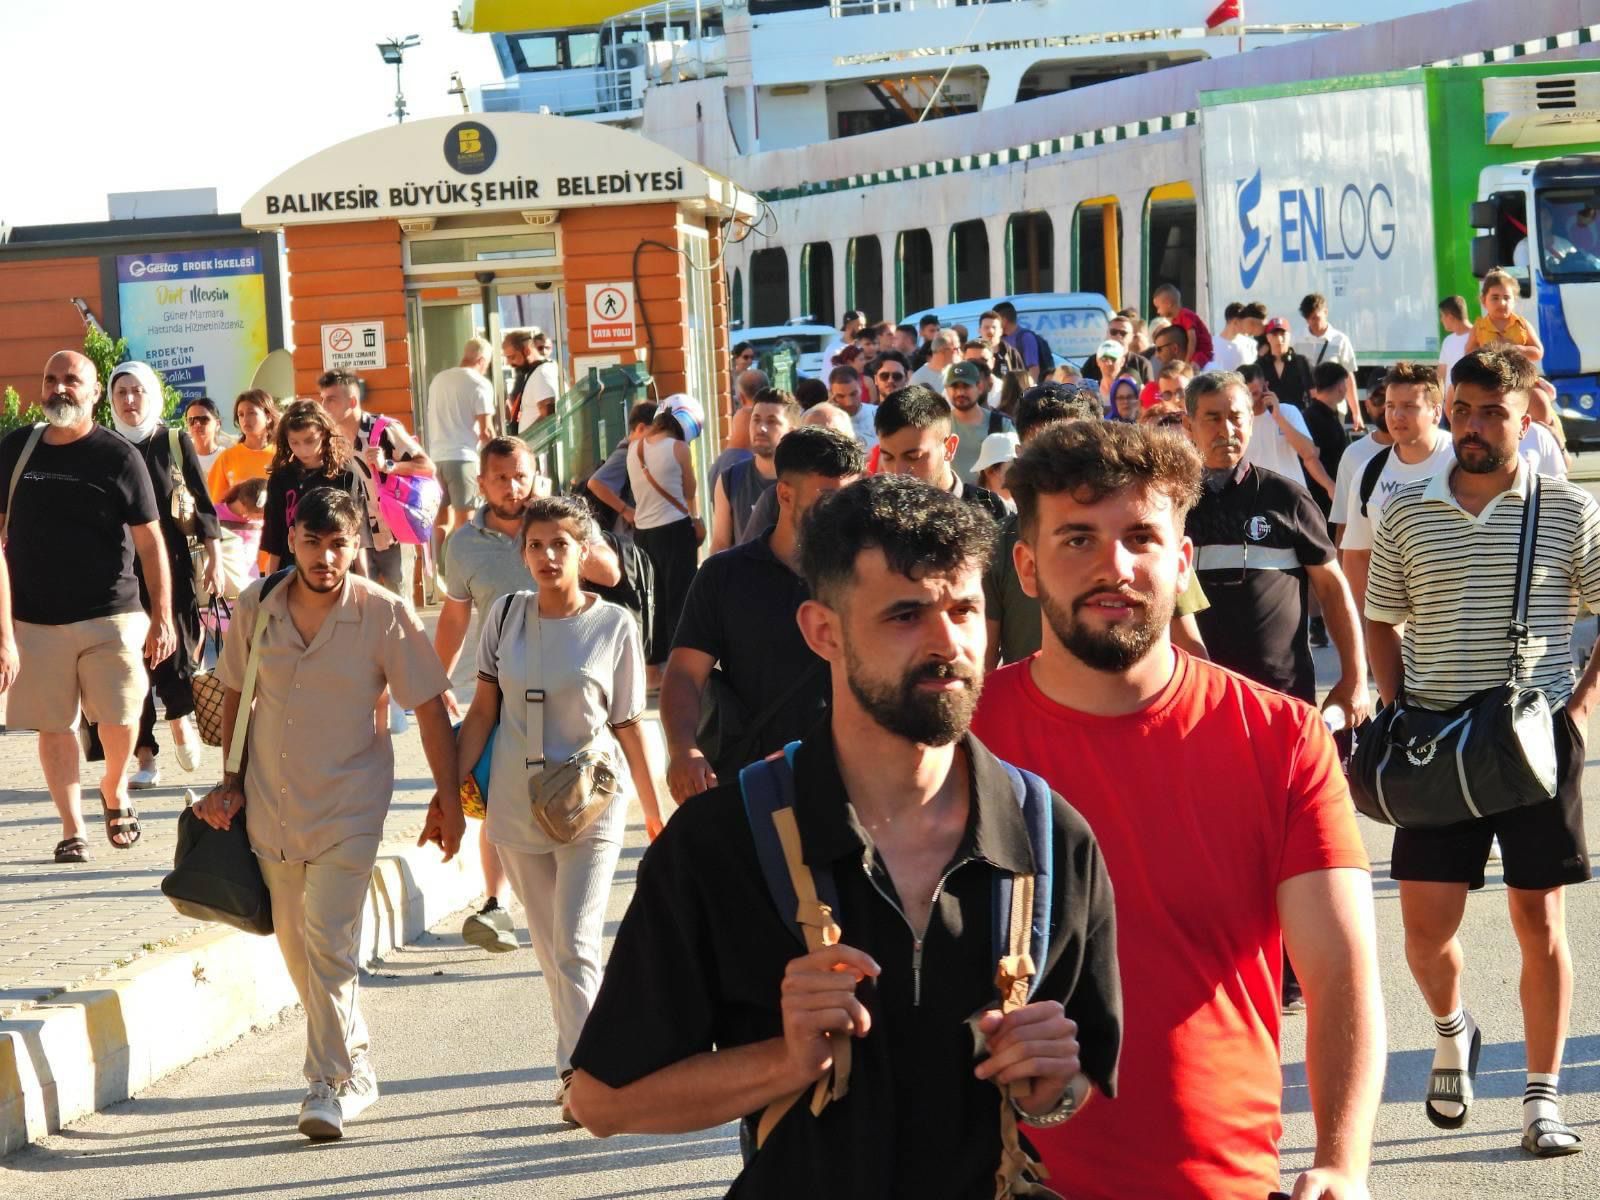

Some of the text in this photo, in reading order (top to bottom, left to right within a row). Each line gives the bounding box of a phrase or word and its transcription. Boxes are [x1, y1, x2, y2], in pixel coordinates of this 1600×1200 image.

[265, 167, 683, 214] BALIKESİR BÜYÜKŞEHİR BELEDİYESİ
[1279, 183, 1396, 263] ENLOG
[146, 256, 255, 273] Gestaş ERDEK İSKELESİ
[163, 309, 224, 322] Güney Marmara
[593, 327, 631, 338] YAYA YOLU
[150, 355, 192, 369] HER GÜN
[1434, 1076, 1458, 1094] WALK
